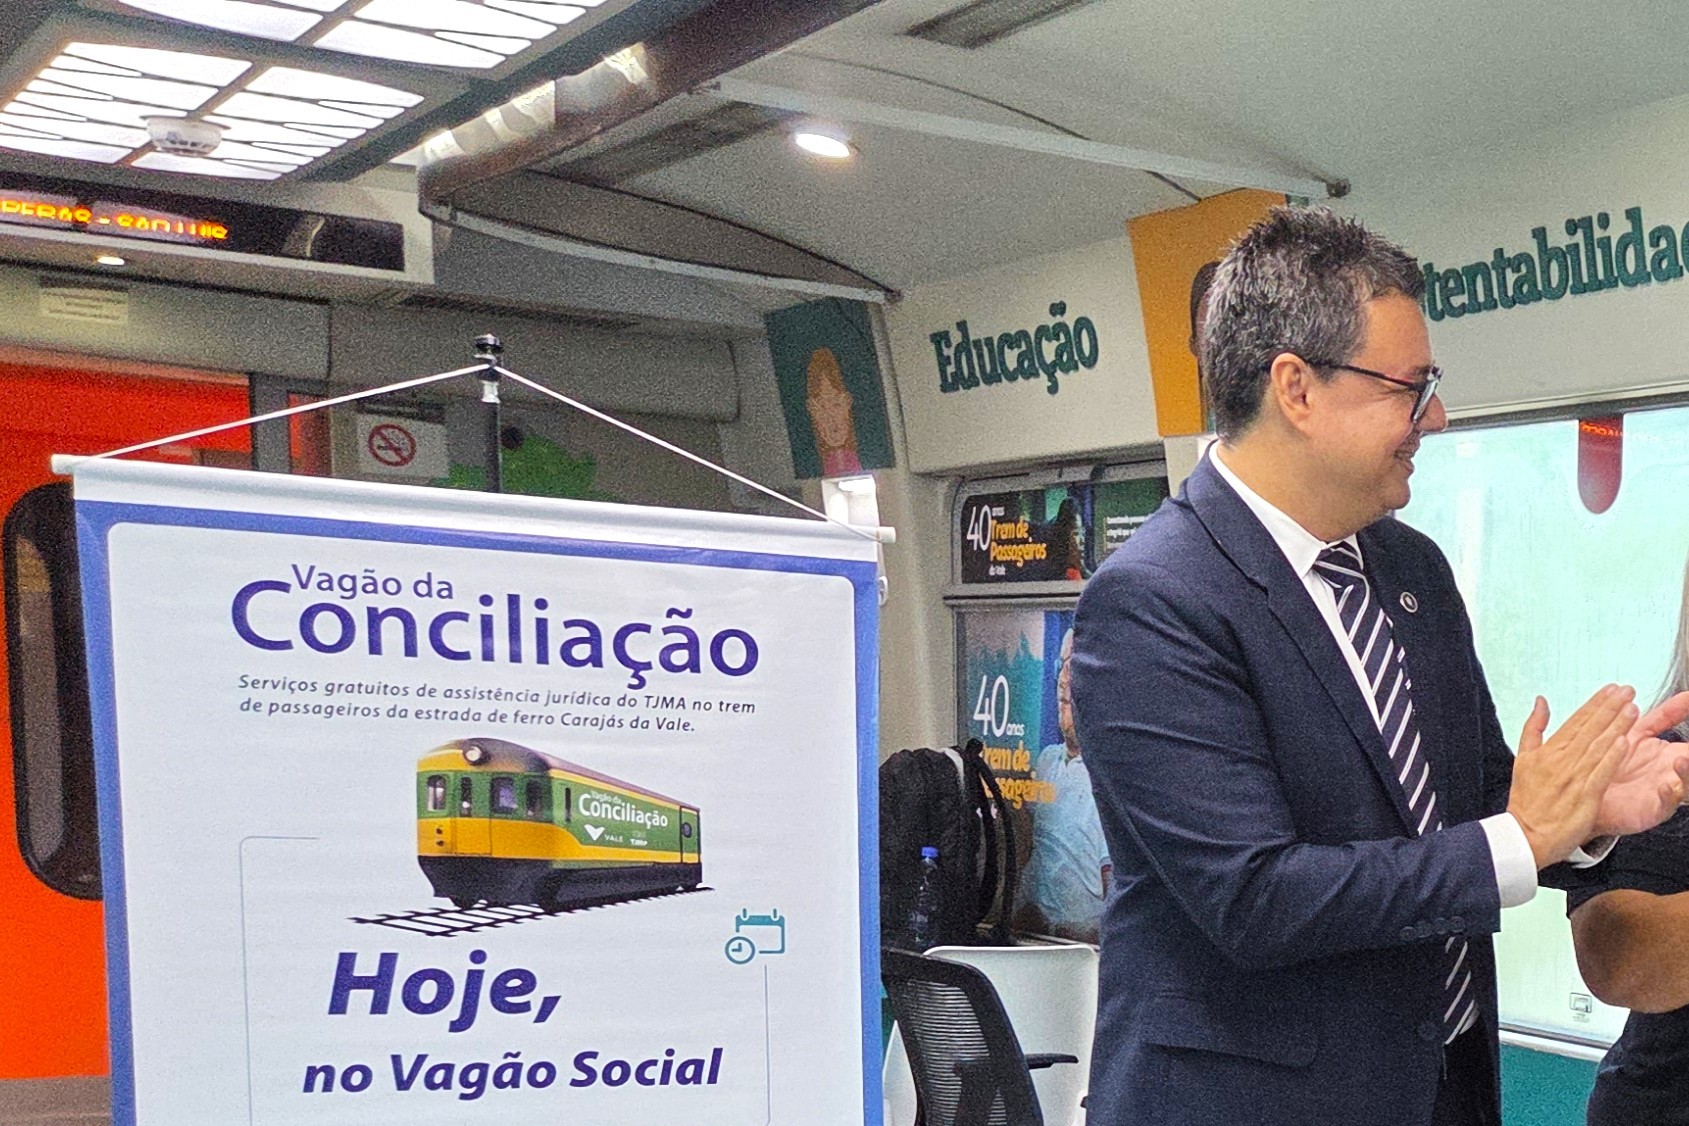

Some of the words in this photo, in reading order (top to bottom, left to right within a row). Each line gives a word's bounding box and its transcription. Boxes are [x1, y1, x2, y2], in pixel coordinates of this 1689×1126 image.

[929, 301, 1100, 395] Educação
[966, 504, 992, 552] 40
[291, 563, 402, 600] Vagão
[413, 571, 454, 600] da
[231, 578, 760, 690] Conciliação
[238, 674, 319, 697] Serviços
[324, 679, 410, 701] gratuitos
[416, 682, 438, 699] de
[443, 684, 540, 705] assistência
[544, 688, 611, 709] jurídica
[617, 691, 639, 708] do
[644, 695, 687, 712] TJMA
[692, 700, 713, 713] no
[718, 698, 756, 715] trem
[239, 696, 263, 713] de
[268, 699, 381, 723] passageiros
[386, 702, 409, 720] da
[414, 705, 483, 723] estrada
[487, 706, 508, 723] de
[513, 707, 555, 727] ferro
[560, 711, 624, 731] Carajás
[630, 714, 651, 730] da
[656, 716, 696, 733] Vale.
[972, 674, 1010, 738] 40
[579, 793, 668, 829] Conciliação
[327, 949, 563, 1033] Hoje,
[303, 1063, 372, 1094] no
[390, 1051, 558, 1100] Vagão
[570, 1047, 723, 1088] Social
